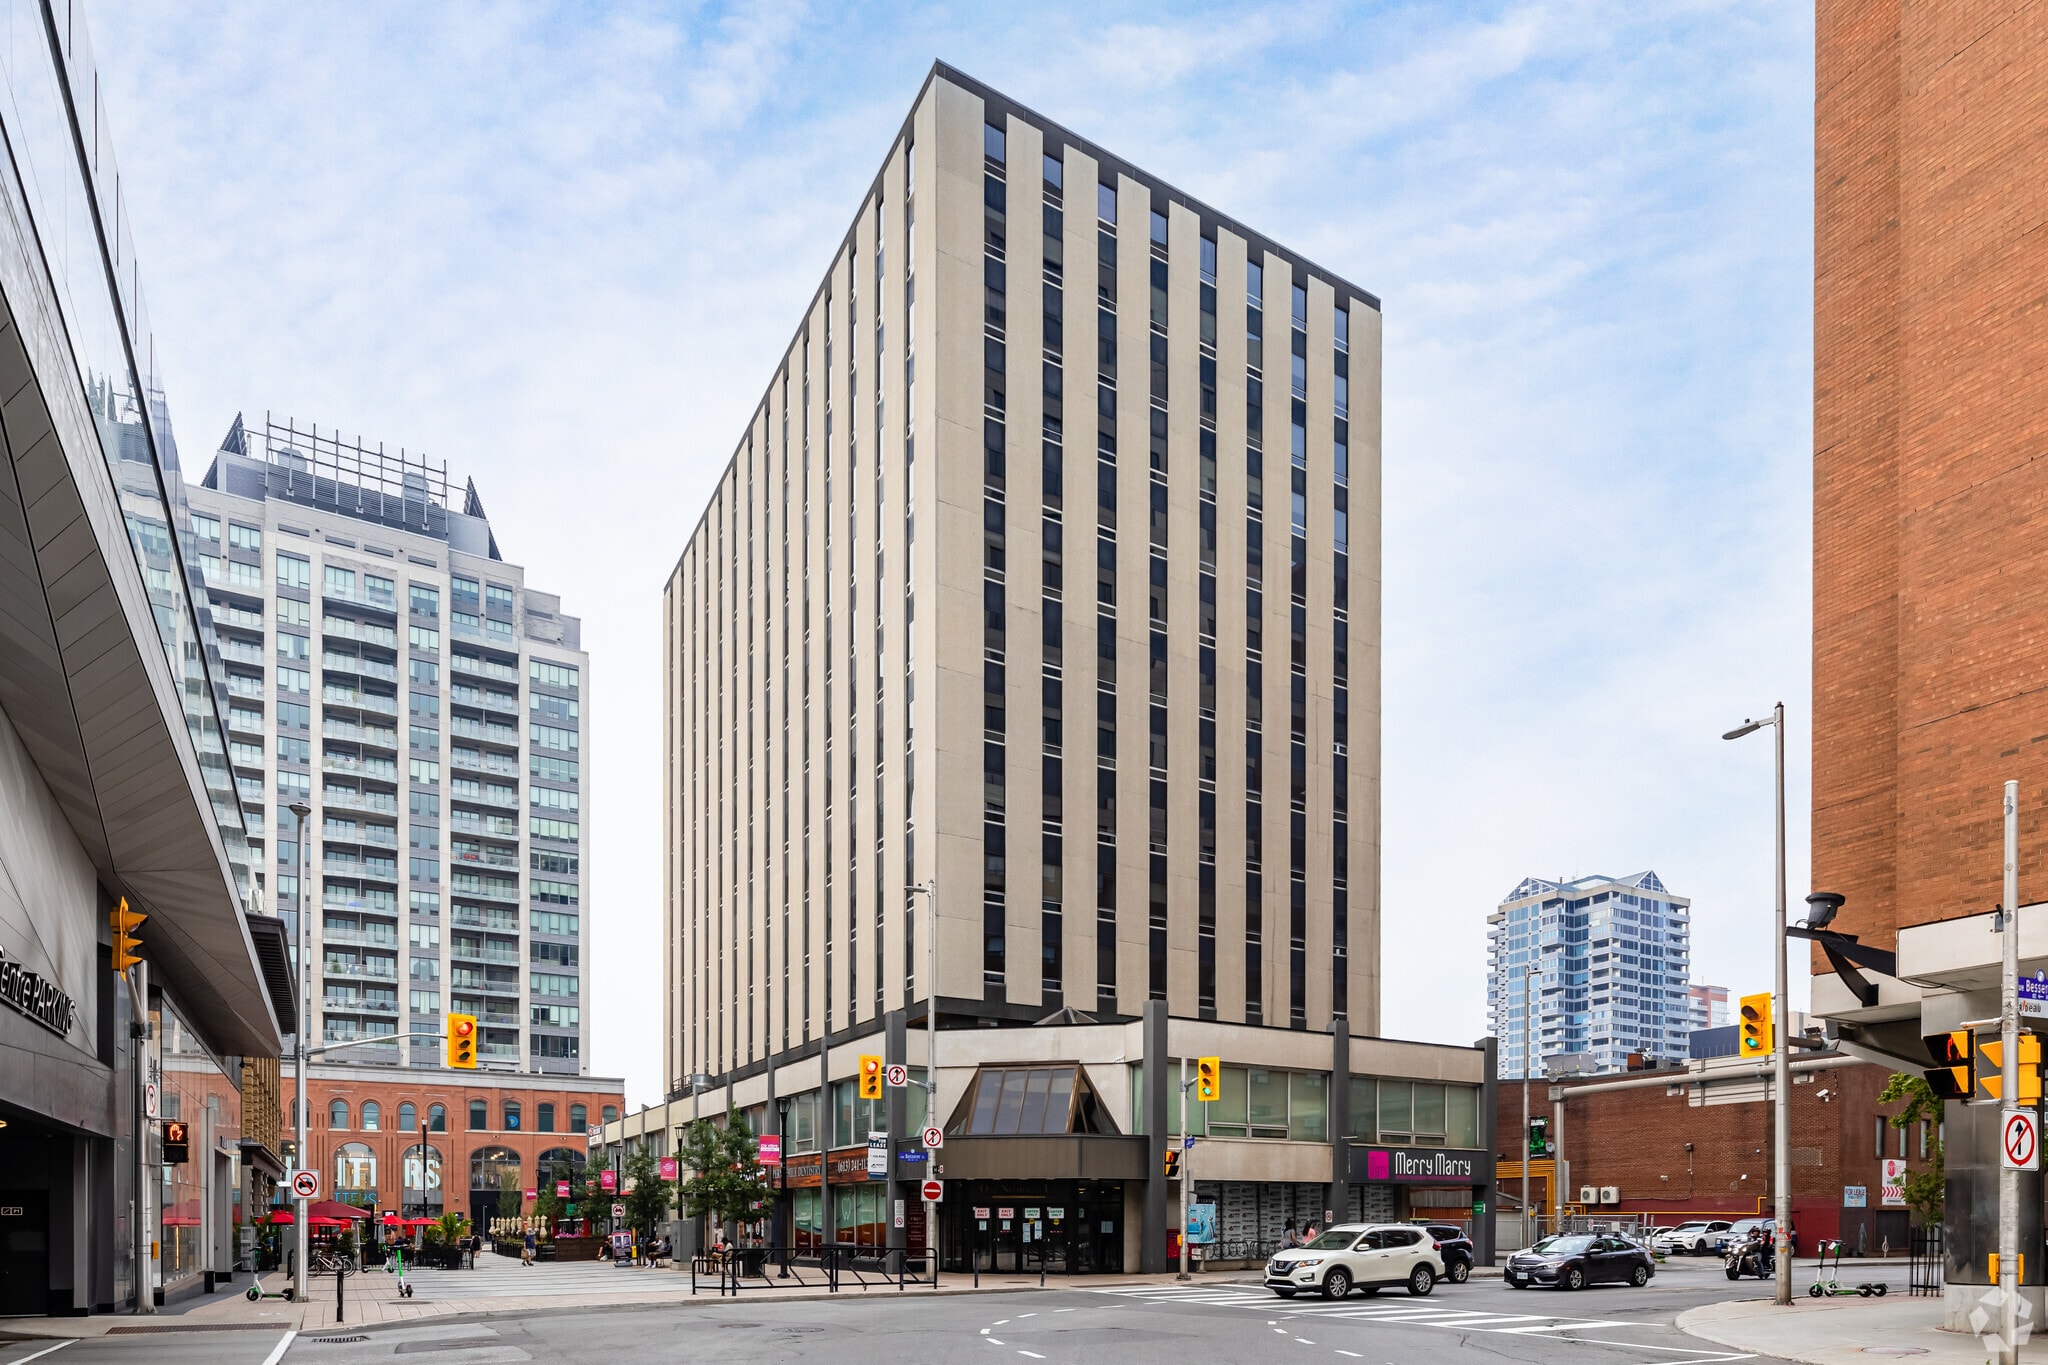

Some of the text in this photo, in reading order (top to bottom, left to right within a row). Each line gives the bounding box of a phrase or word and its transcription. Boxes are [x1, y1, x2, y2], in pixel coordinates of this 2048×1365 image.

[31, 974, 77, 1034] PARKING
[798, 1165, 821, 1177] DENTISTRY
[1395, 1152, 1433, 1175] Merry
[1435, 1153, 1471, 1176] Marry
